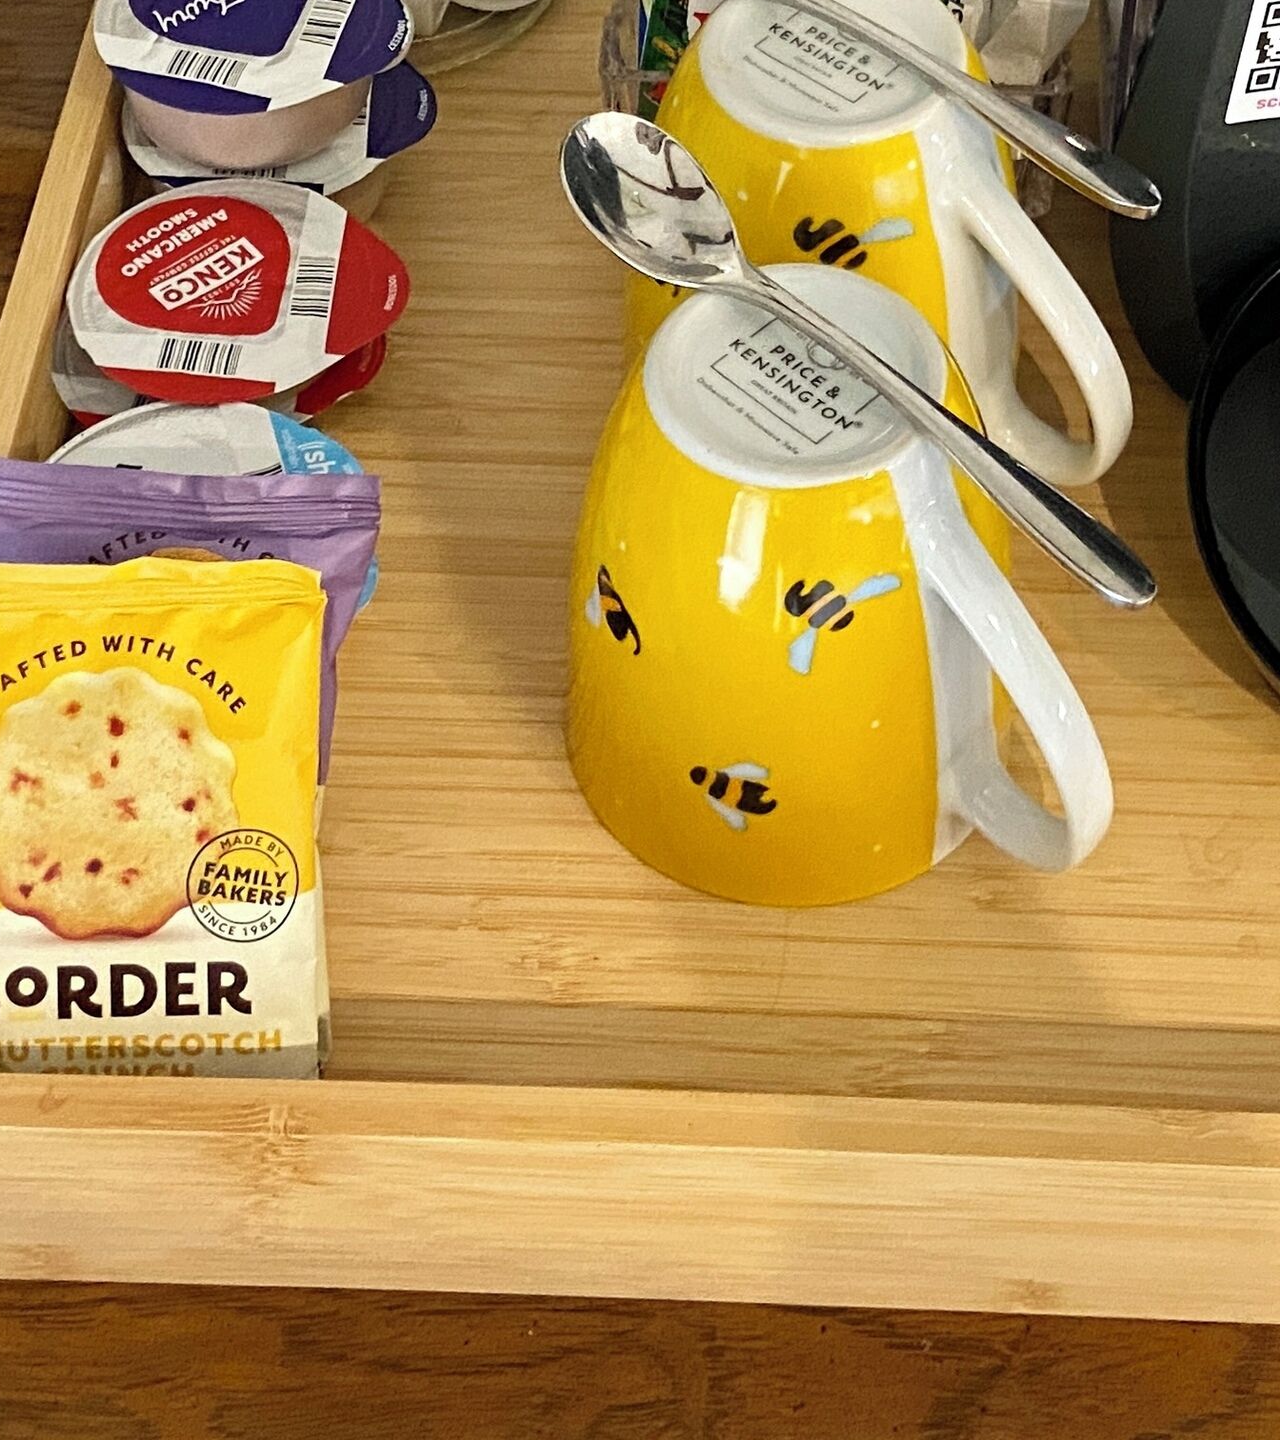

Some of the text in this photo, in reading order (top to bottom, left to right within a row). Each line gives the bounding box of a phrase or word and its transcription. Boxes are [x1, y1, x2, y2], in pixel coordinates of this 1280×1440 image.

[768, 22, 887, 91] KENSINGTON
[804, 25, 871, 65] PRICE &
[121, 208, 229, 278] AMERICANO
[125, 208, 199, 253] SMOOTH
[190, 244, 221, 262] COFFEE
[160, 244, 256, 304] KENCO
[728, 338, 854, 430] KENSINGTON
[770, 344, 828, 389] PRICE
[826, 385, 841, 401] &
[102, 634, 177, 663] WITH
[185, 657, 247, 714] CARE
[219, 834, 285, 858] MADE BY
[197, 878, 288, 906] BAKERS
[203, 861, 289, 888] FAMILY
[198, 905, 277, 937] SINCE 1984
